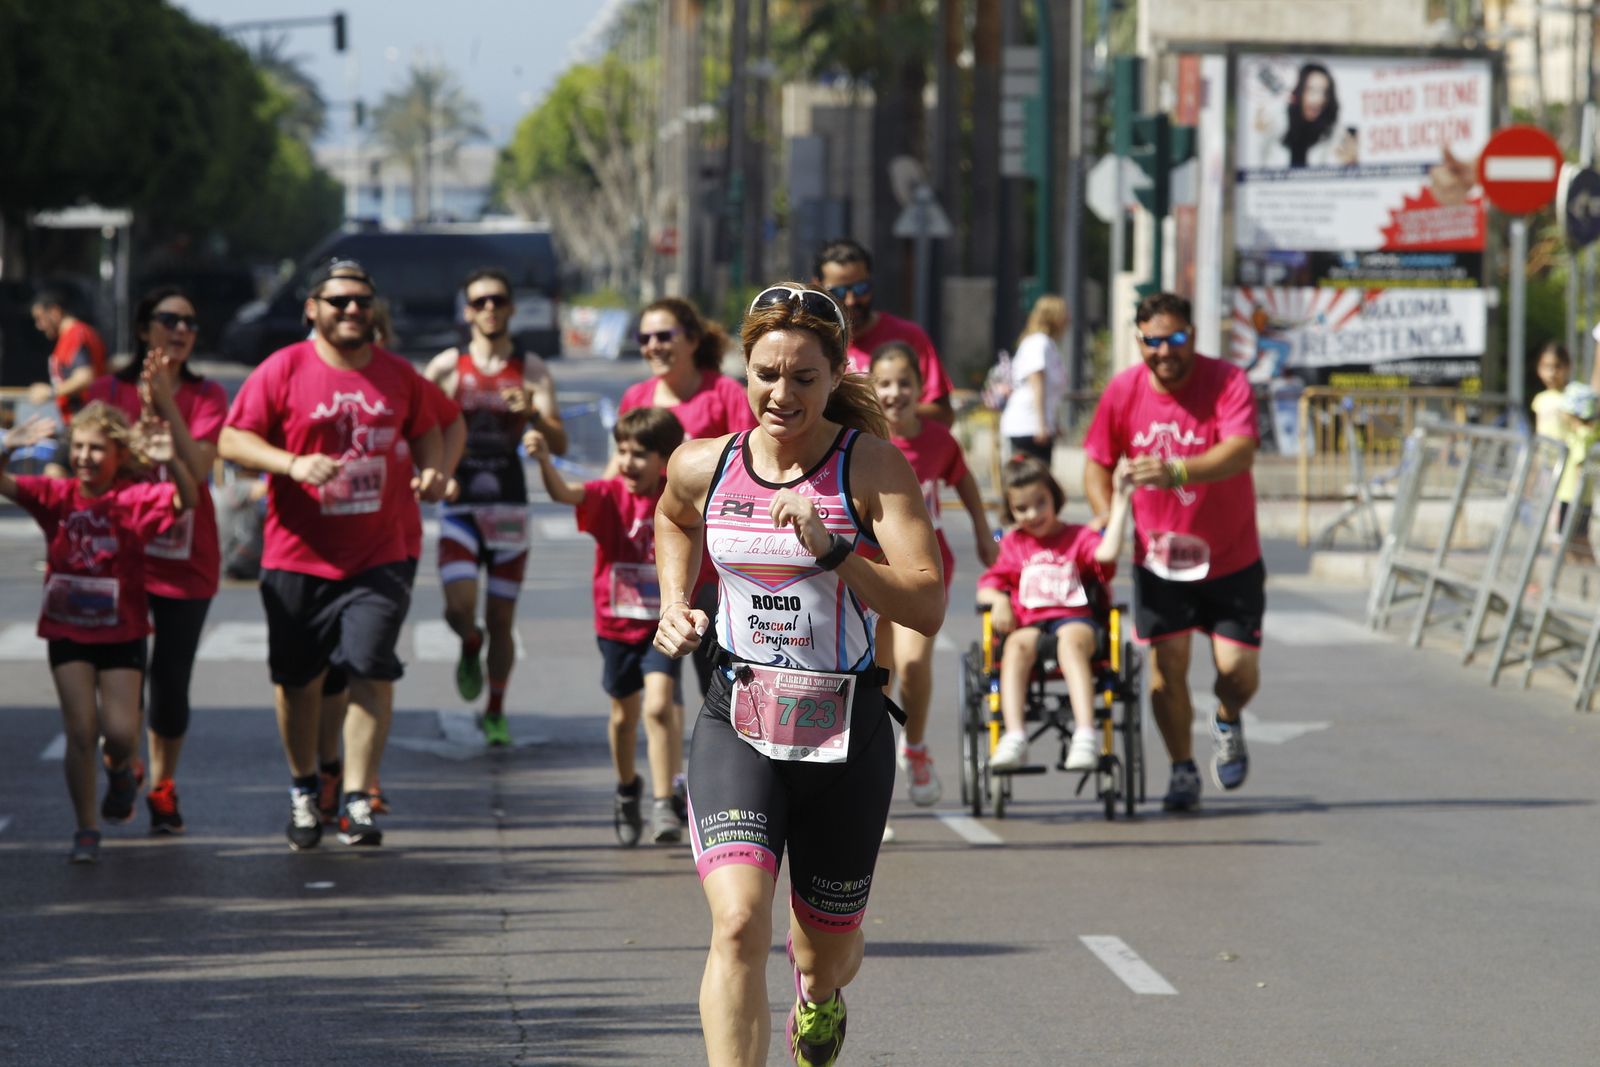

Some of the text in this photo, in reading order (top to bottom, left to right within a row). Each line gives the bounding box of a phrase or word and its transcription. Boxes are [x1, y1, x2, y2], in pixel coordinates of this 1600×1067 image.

[1361, 75, 1479, 118] TODO TIENE
[1300, 324, 1464, 356] RESISTENCIA
[720, 500, 754, 518] 24
[744, 537, 761, 554] La
[761, 535, 792, 556] Dulce
[751, 595, 801, 611] ROCIO
[747, 614, 798, 631] Pascual
[752, 631, 810, 651] Cirujanos
[780, 673, 812, 686] CARRERA
[777, 696, 836, 729] 723
[708, 851, 752, 864] TREK
